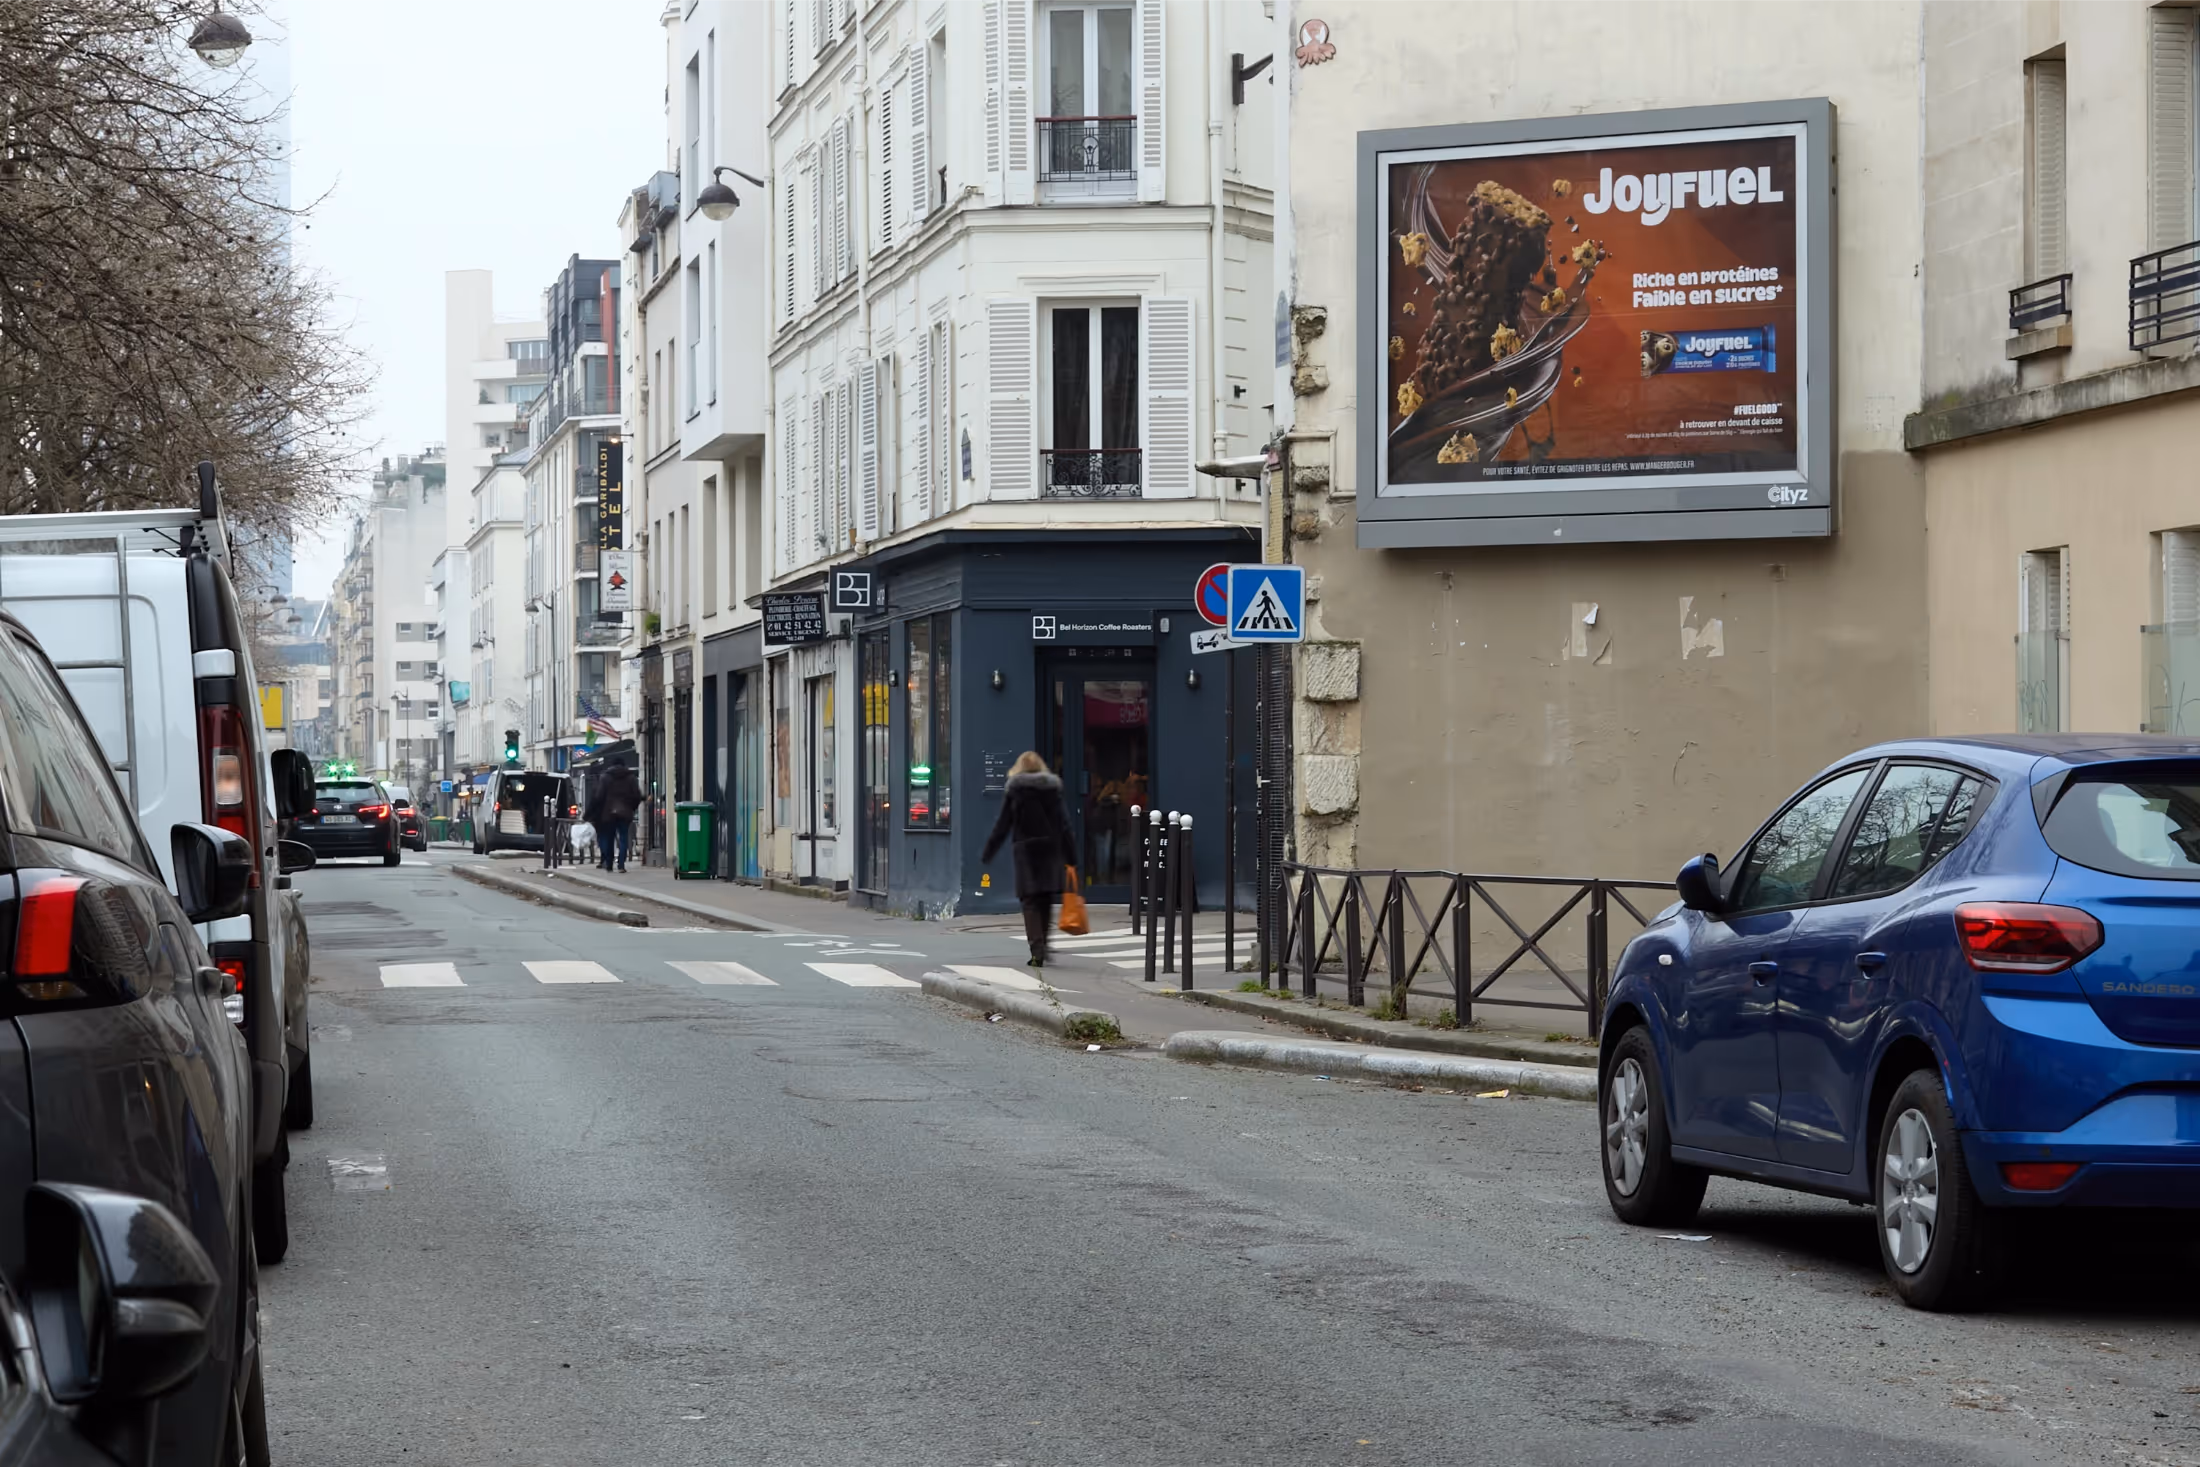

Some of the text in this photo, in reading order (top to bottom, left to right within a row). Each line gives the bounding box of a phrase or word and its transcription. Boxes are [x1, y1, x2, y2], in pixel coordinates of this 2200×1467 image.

[1633, 265, 1778, 288] Riche en protéines
[1633, 289, 1686, 308] Faible
[1689, 288, 1712, 305] en
[1679, 420, 1684, 429] à
[1685, 419, 1717, 429] retrouver
[1728, 417, 1750, 427] devant
[1751, 417, 1760, 426] de
[1761, 417, 1783, 425] caisse
[1482, 467, 1496, 476] POUR
[1497, 466, 1513, 476] VOTRE
[1549, 465, 1556, 474] DE
[1585, 463, 1601, 472] ENTRE
[1601, 463, 1611, 472] LES
[599, 448, 608, 519] GARIBALDI
[1767, 486, 1808, 504] Cityz
[774, 620, 822, 631] 01 42 51 42 42
[1059, 623, 1151, 631] Bel Horizon Coffee Roasters
[2102, 981, 2195, 995] SANDERO
